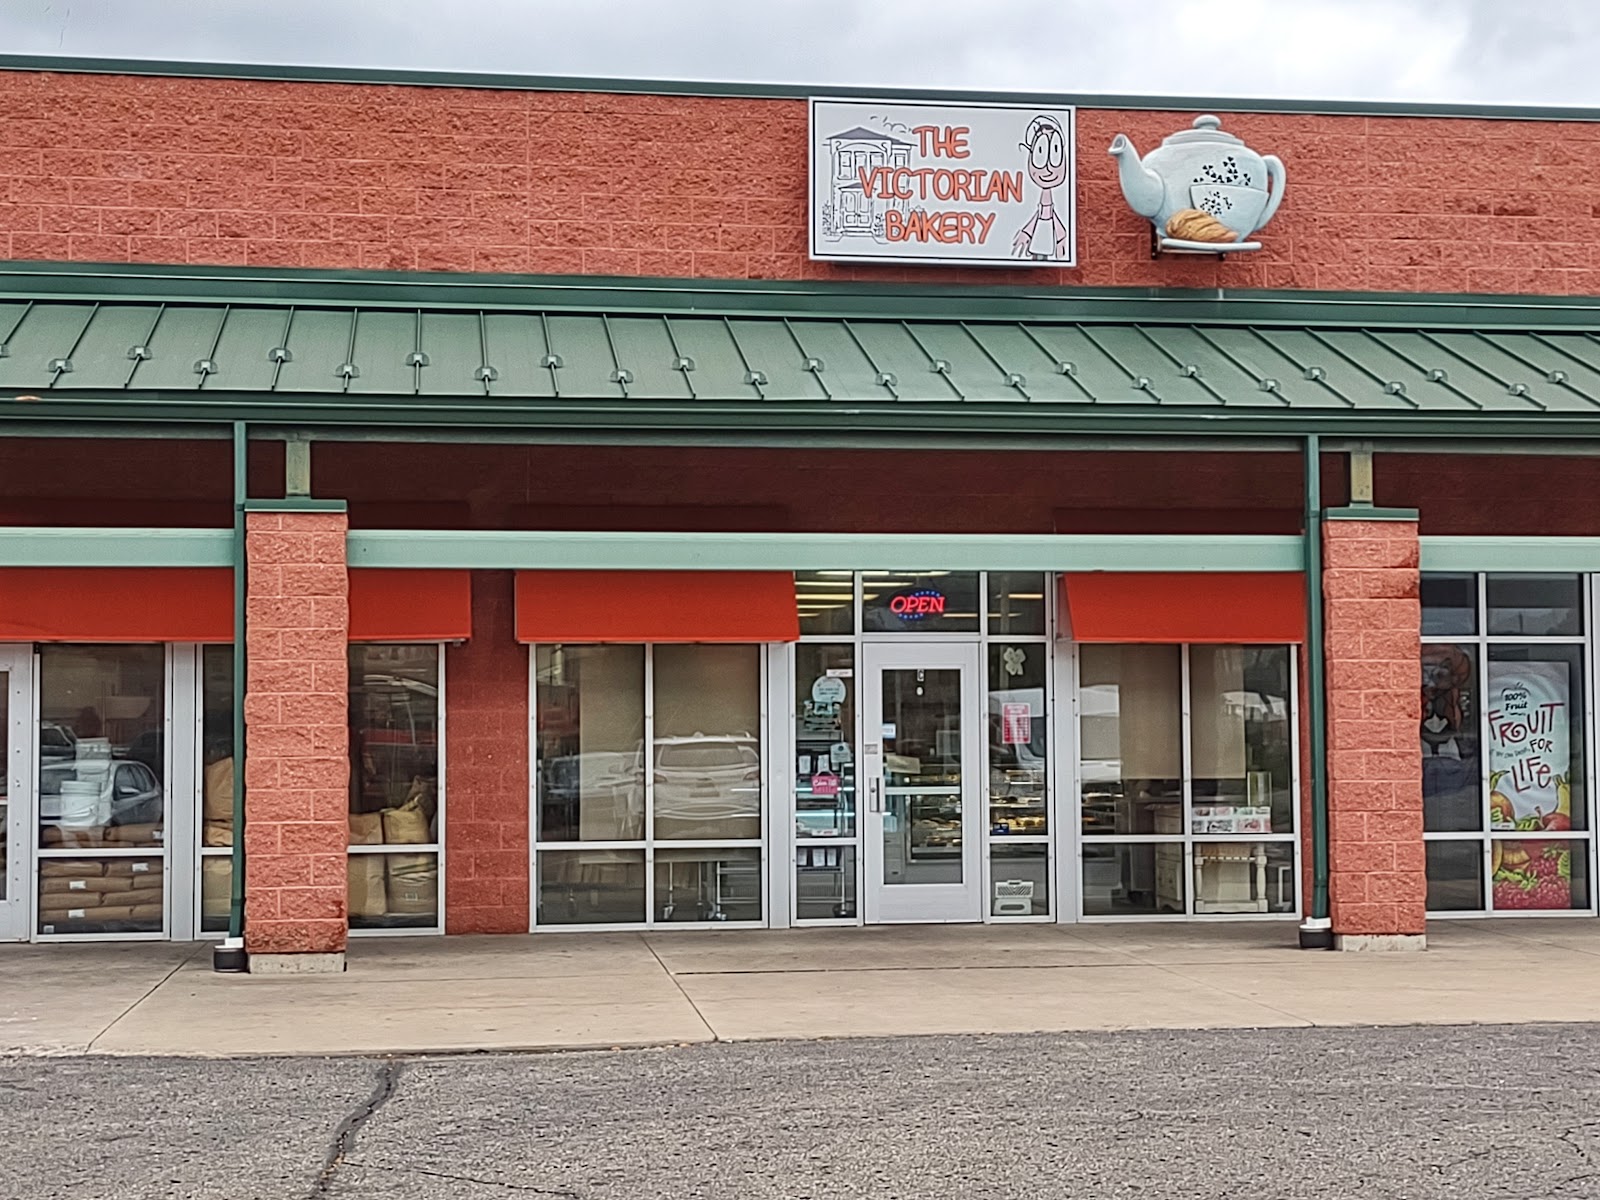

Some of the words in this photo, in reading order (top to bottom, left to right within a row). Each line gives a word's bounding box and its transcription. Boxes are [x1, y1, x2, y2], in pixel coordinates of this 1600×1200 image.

[911, 126, 971, 159] THE
[858, 166, 1024, 202] VICTORIAN
[884, 210, 996, 244] BAKERY
[890, 595, 946, 613] OPEN
[1504, 692, 1527, 701] 100%
[1505, 701, 1528, 711] Fruit
[1488, 702, 1565, 748] FRUIT
[1529, 738, 1553, 753] FOR
